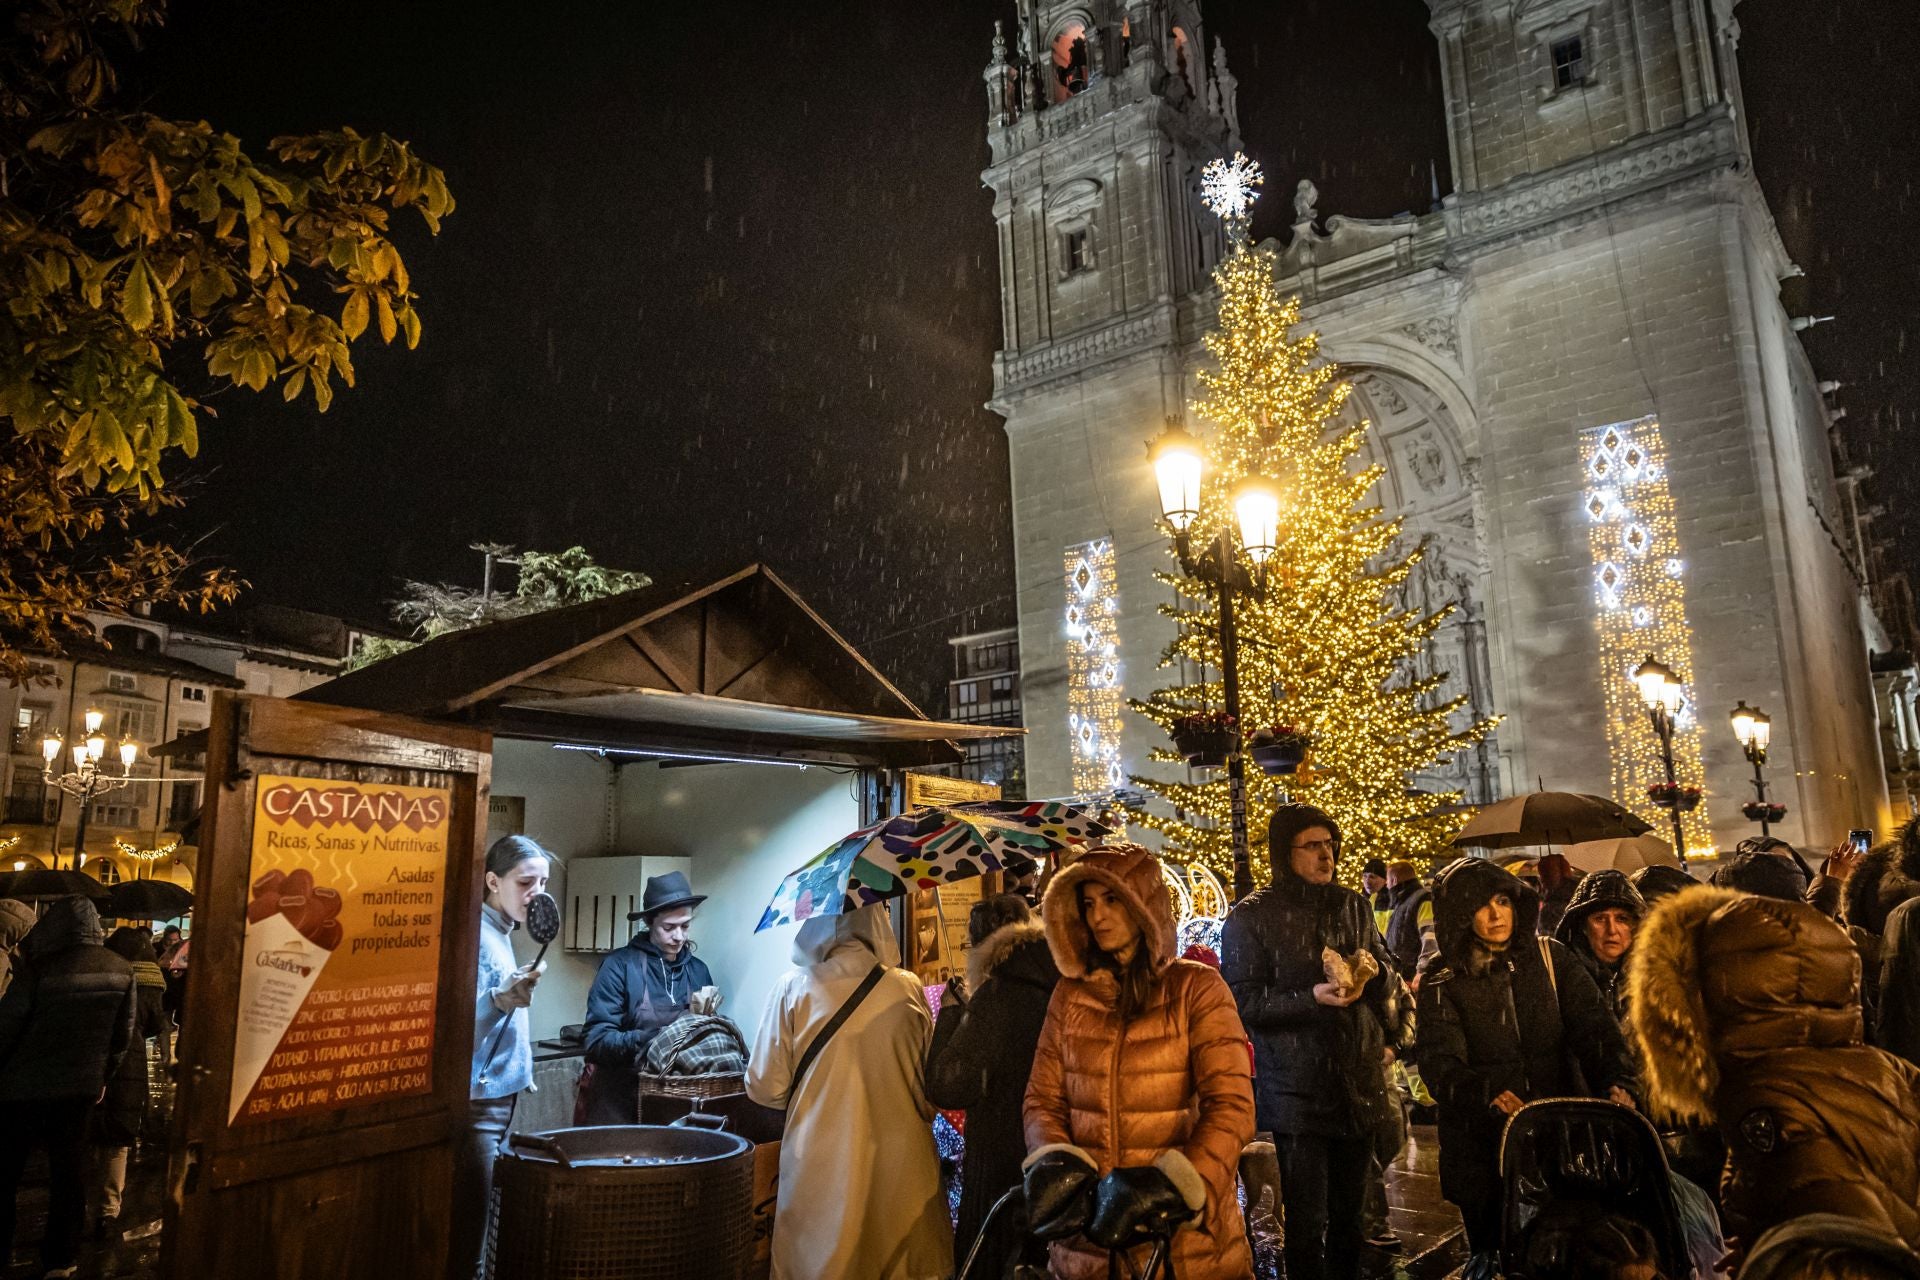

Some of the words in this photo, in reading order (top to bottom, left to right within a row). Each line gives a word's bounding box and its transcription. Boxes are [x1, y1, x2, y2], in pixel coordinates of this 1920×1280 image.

[265, 788, 441, 823] CASTAÑAS
[267, 830, 311, 849] Ricas,
[315, 833, 355, 849] Sanas
[360, 839, 369, 854] y
[373, 835, 441, 852] Nutritivas.
[386, 866, 434, 883] Asadas
[362, 889, 433, 904] mantienen
[373, 909, 408, 926] todas
[412, 913, 432, 925] sus
[352, 931, 431, 953] propiedades
[276, 1092, 304, 1109] AGUA
[358, 1080, 372, 1095] UN
